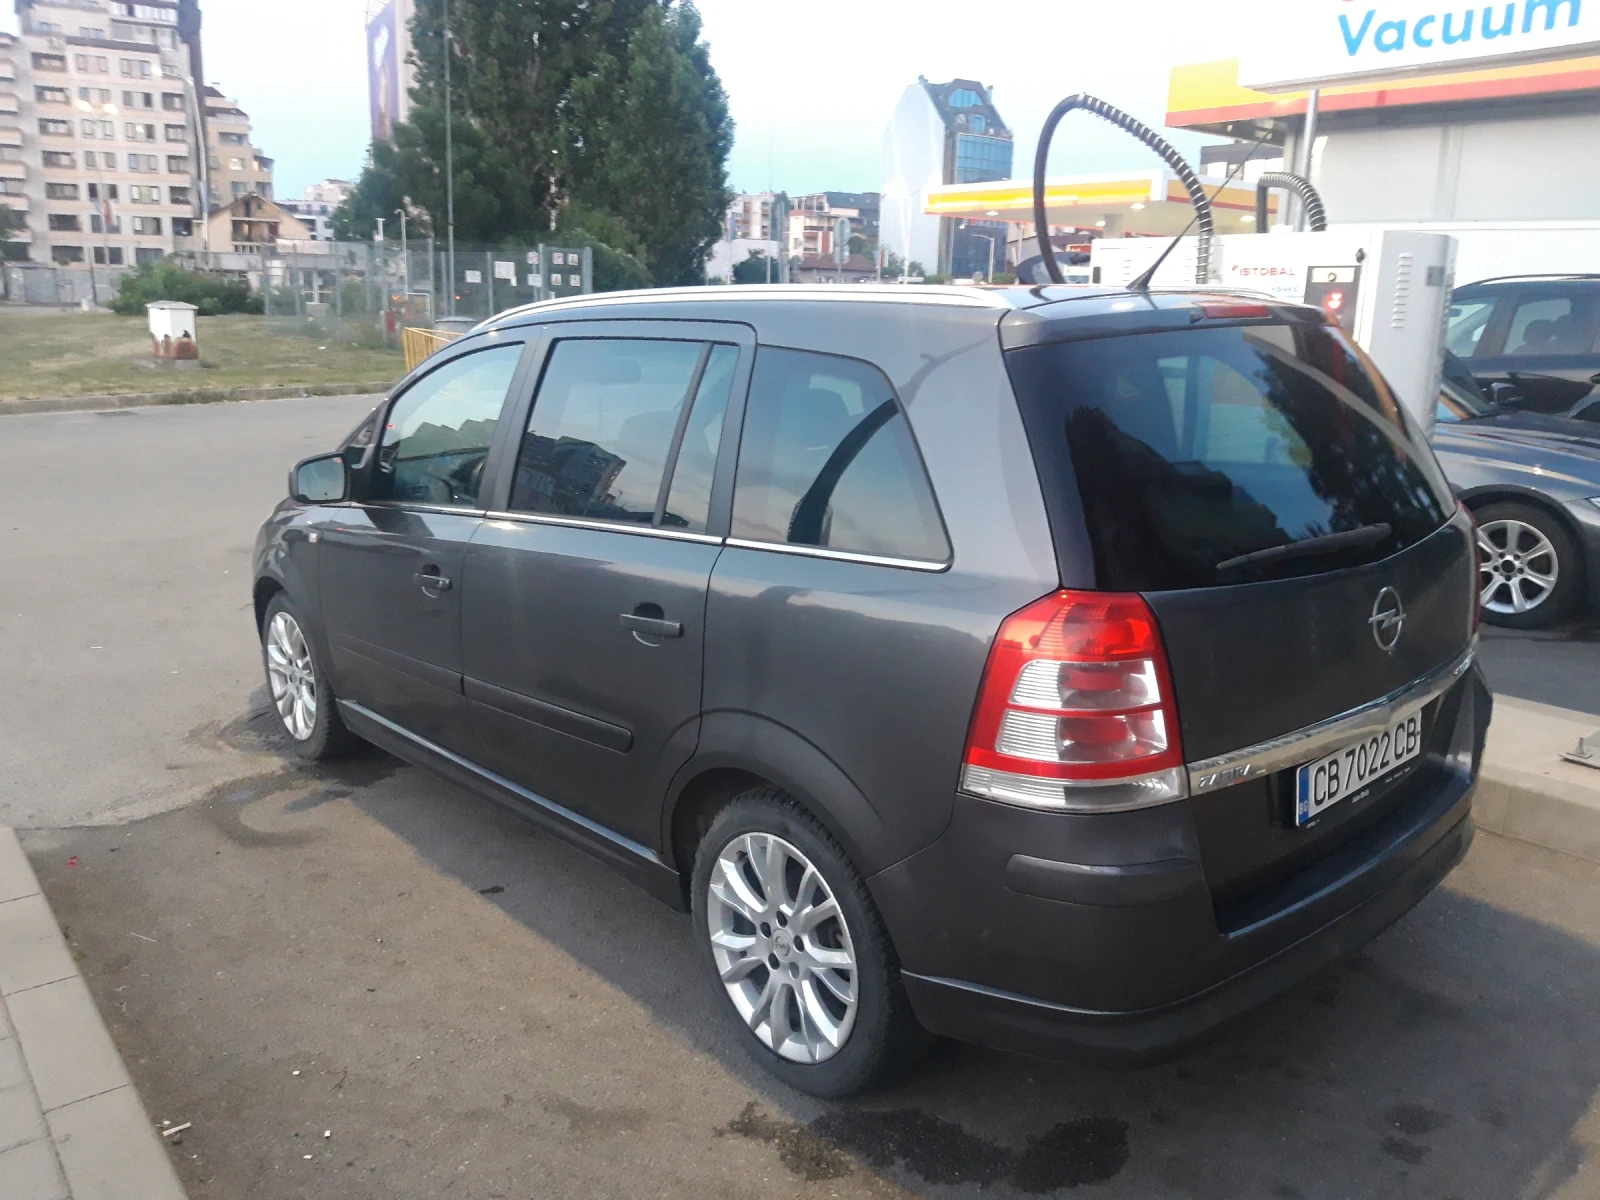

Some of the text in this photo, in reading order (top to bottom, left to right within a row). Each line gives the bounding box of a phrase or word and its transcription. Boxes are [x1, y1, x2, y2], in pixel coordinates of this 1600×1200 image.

[1338, 0, 1582, 57] Vacuum
[1239, 267, 1296, 276] ISTOBAL
[1313, 717, 1417, 806] CB 7022 CB
